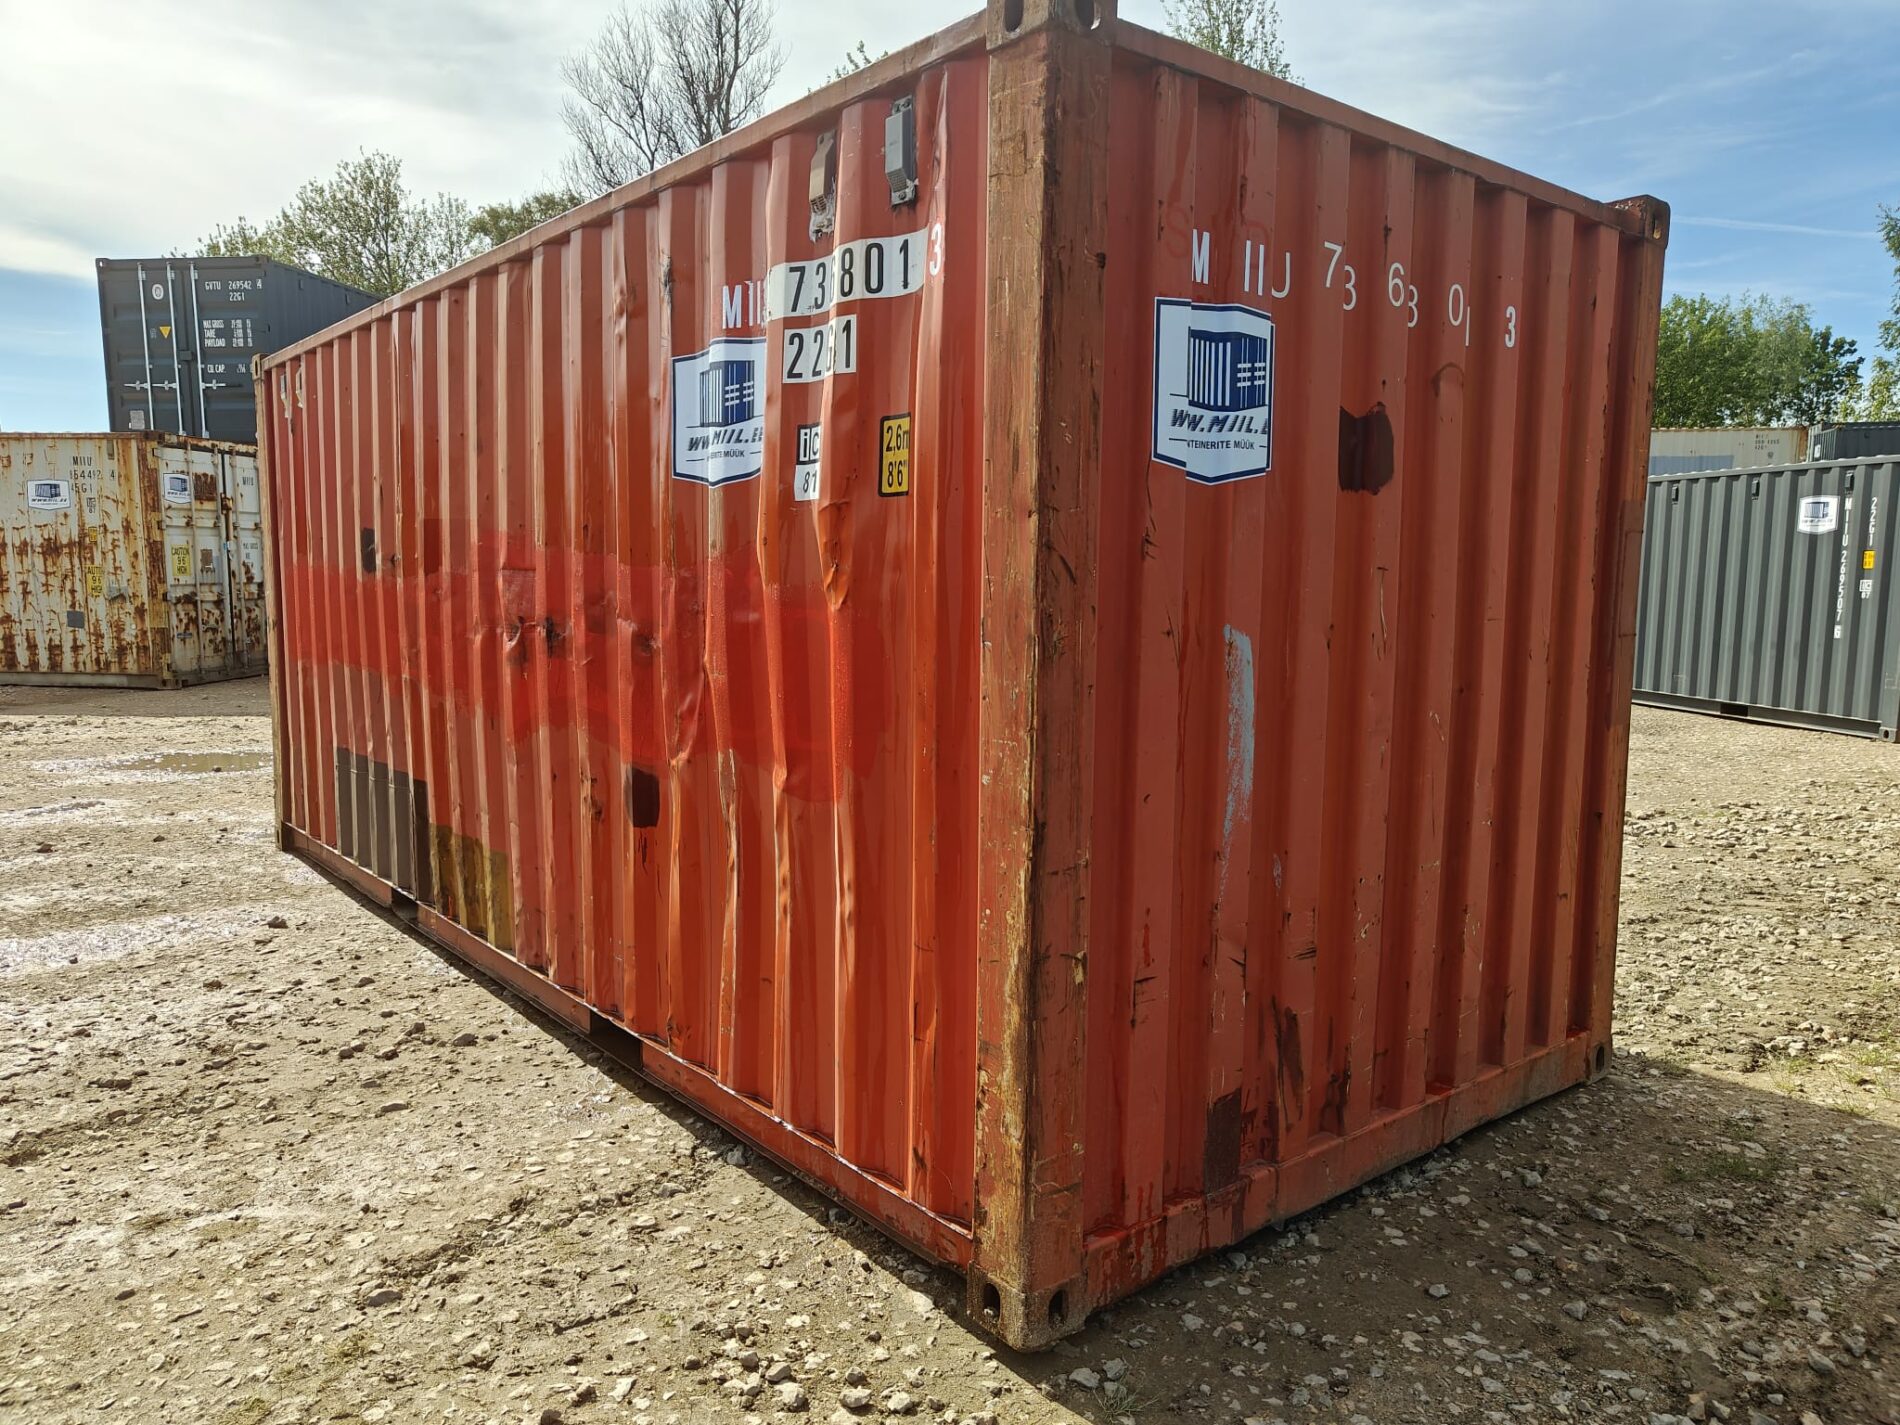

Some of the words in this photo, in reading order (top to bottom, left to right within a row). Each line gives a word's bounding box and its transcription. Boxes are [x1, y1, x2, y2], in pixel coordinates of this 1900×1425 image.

[228, 280, 252, 290] 269542
[722, 279, 767, 329] MII
[929, 222, 943, 277] 3
[1504, 305, 1516, 348] 3
[72, 455, 92, 467] MIIU
[723, 448, 746, 458] MÜÜK
[1233, 438, 1255, 450] MÜÜK
[1841, 497, 1853, 547] MIIU
[1867, 496, 1878, 546] 22G1
[1836, 549, 1848, 622] 269507
